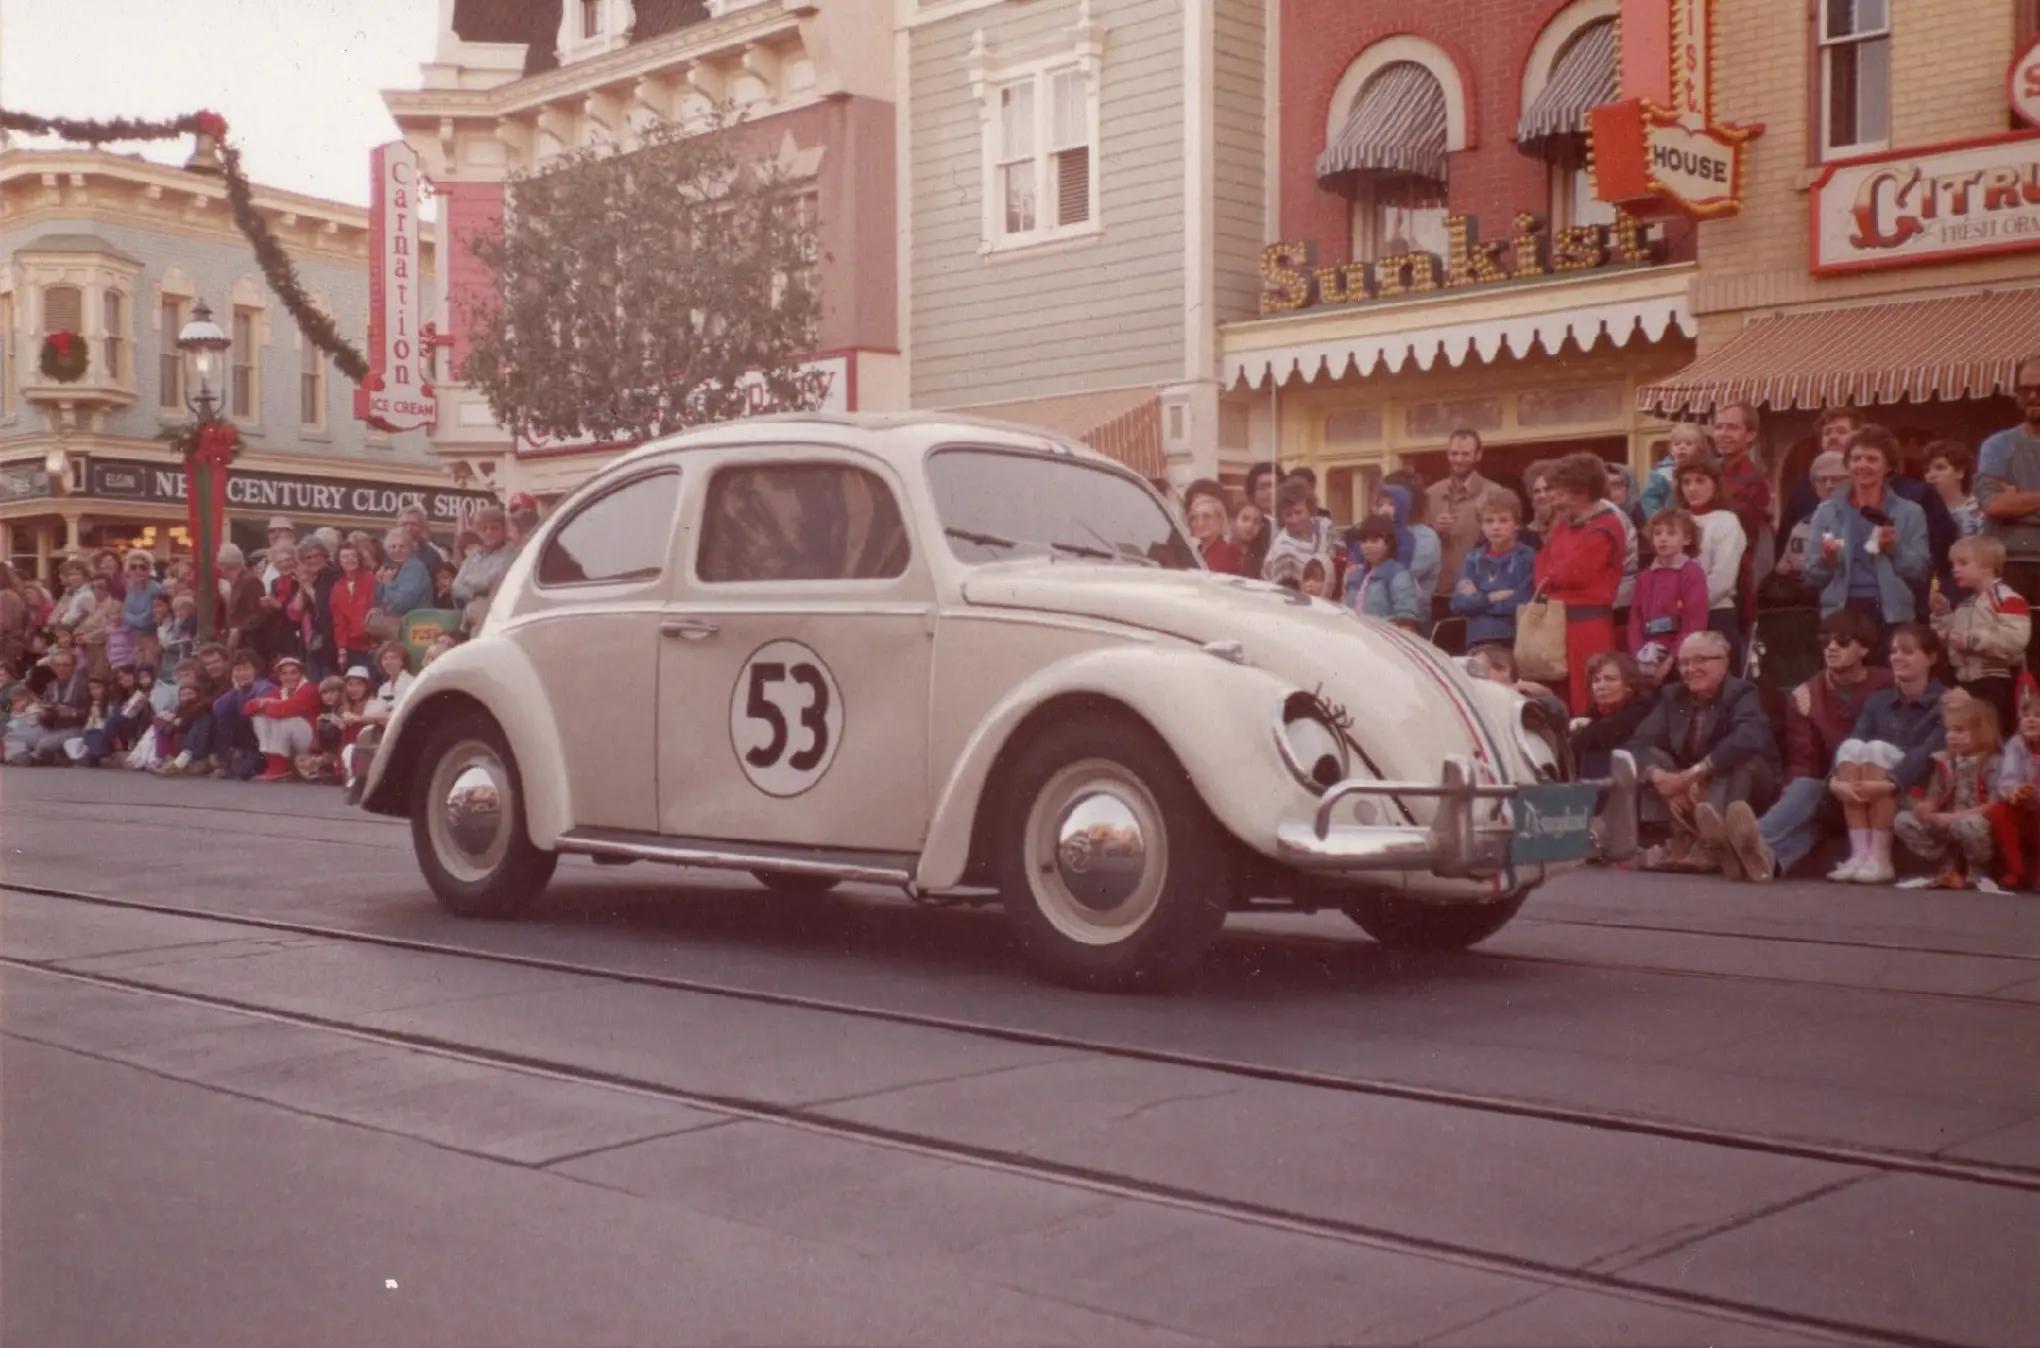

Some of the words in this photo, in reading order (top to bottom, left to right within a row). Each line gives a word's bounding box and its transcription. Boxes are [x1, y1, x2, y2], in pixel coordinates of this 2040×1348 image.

[1653, 144, 1728, 183] HOUSE
[1941, 219, 1998, 243] FRESH
[391, 162, 410, 385] Carnation
[1259, 208, 1655, 317] Sunkist
[393, 400, 434, 416] CREAM
[226, 476, 347, 510] CENTURY
[352, 488, 428, 515] CLOCK
[745, 662, 829, 772] 53
